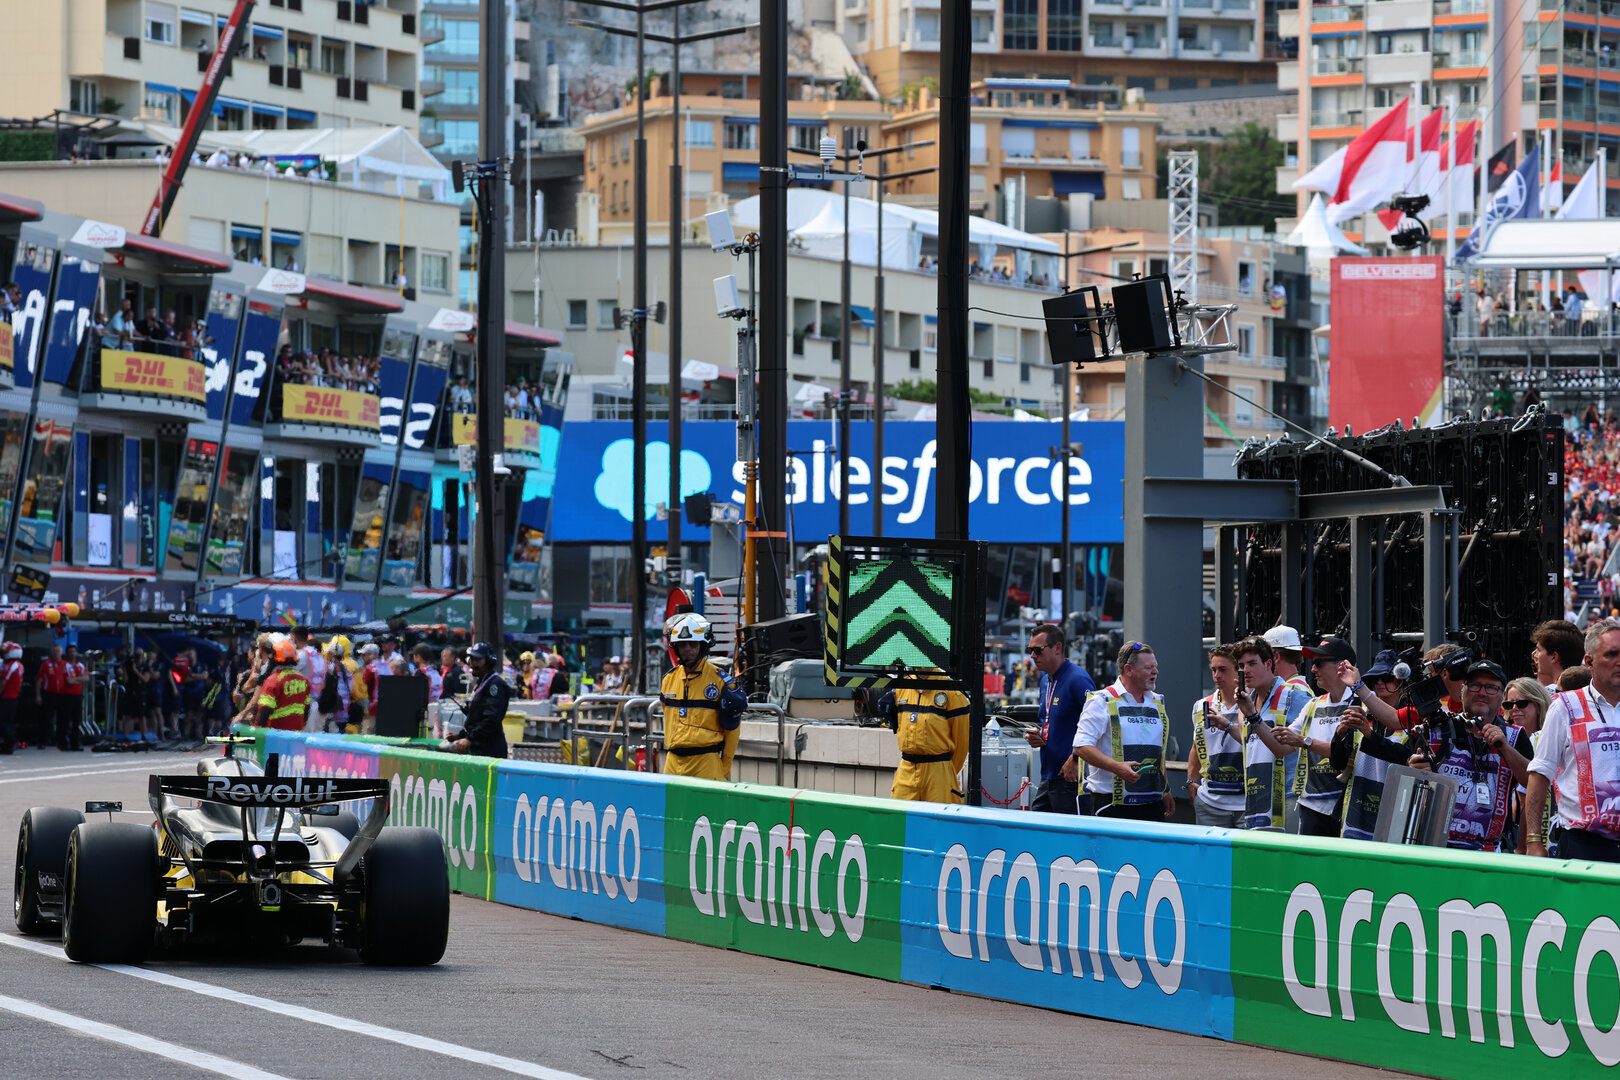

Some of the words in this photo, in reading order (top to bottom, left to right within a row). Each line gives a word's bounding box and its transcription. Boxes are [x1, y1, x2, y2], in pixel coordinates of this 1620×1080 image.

[125, 357, 168, 388] DHL
[305, 391, 342, 418] DHL
[206, 776, 338, 804] Revolut
[1293, 763, 1306, 796] ONACO
[1495, 766, 1511, 816] MONACO
[390, 772, 477, 871] aramco
[1449, 818, 1485, 840] EDIA
[513, 792, 641, 904] aramco
[689, 815, 868, 943] aramco
[937, 842, 1186, 996] aramco
[1281, 881, 1620, 1067] aramco
